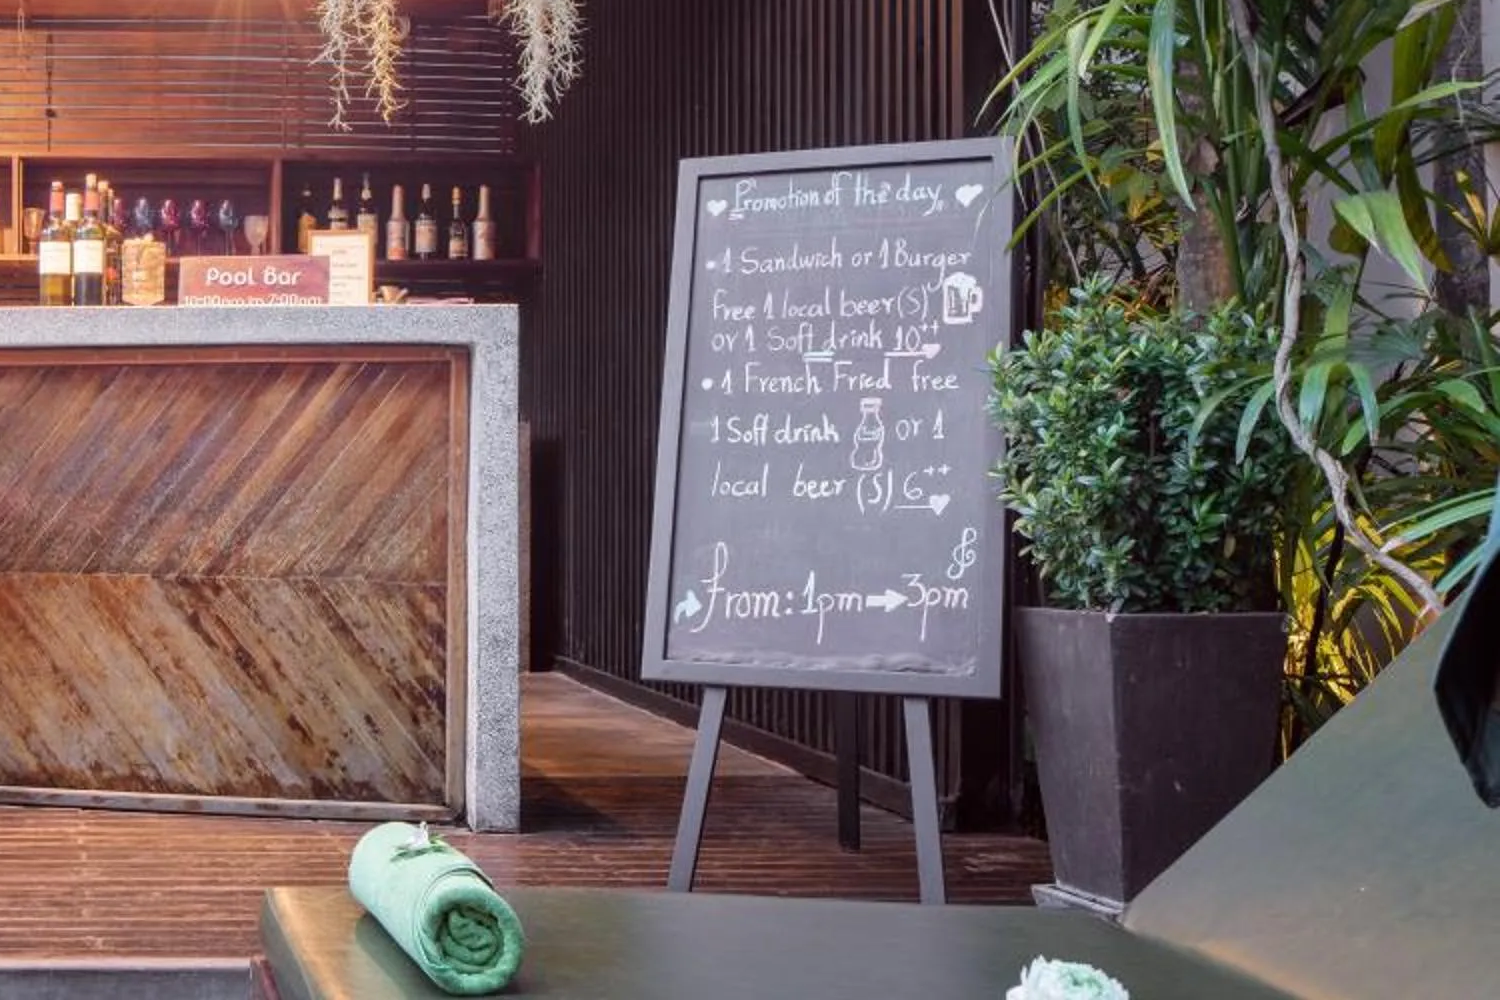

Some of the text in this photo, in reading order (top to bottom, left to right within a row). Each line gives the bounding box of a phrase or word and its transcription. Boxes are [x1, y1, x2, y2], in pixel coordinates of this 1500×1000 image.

[205, 266, 303, 286] Pool Bar
[722, 236, 972, 292] 1 Sandwich or 1 Burger
[763, 291, 775, 320] 1
[781, 286, 831, 319] local
[711, 330, 739, 352] or
[745, 324, 756, 352] 1
[821, 320, 882, 352] drink
[720, 369, 733, 395] 1
[744, 361, 823, 395] French
[774, 413, 840, 444] drink
[895, 419, 923, 441] or
[933, 408, 945, 440] 1
[711, 461, 769, 498] local
[793, 462, 847, 499] beer
